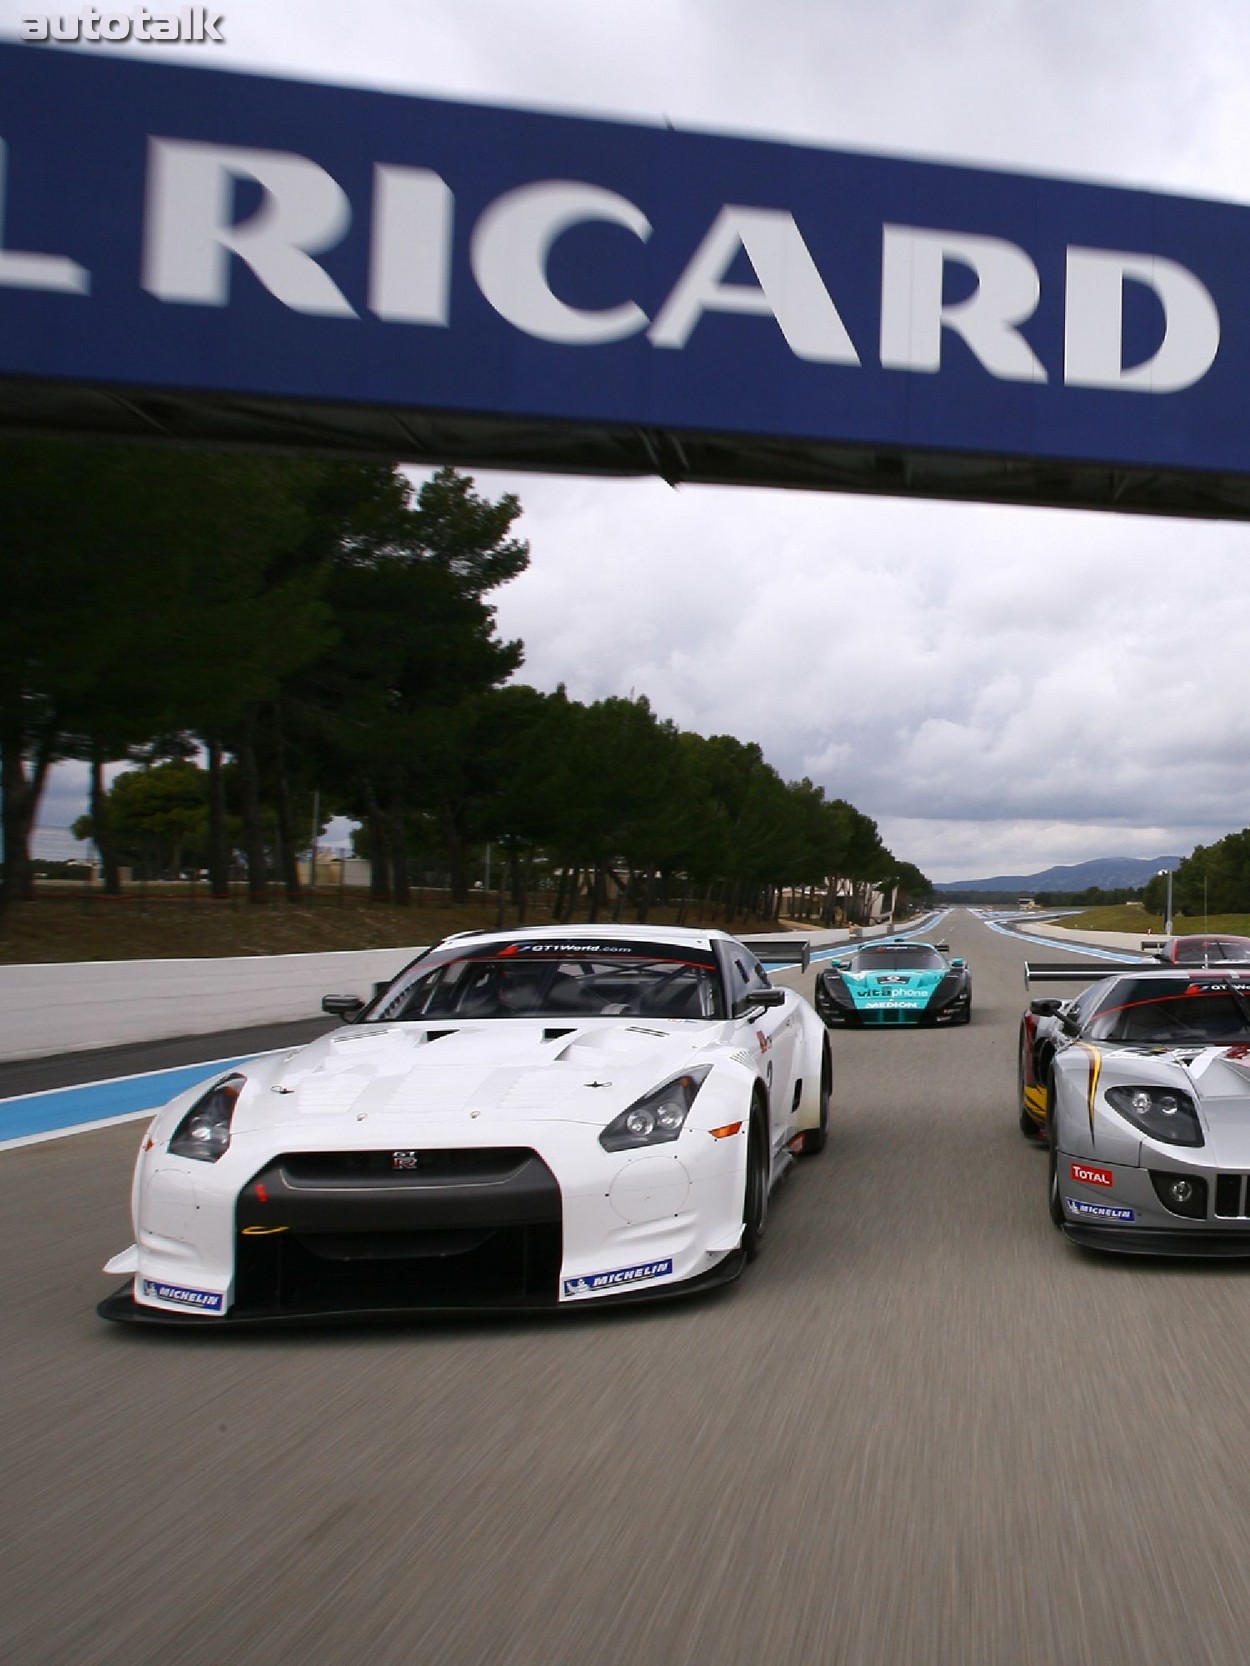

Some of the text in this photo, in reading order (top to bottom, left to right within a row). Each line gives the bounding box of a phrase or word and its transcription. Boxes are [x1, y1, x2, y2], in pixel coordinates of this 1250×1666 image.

[141, 135, 1220, 394] RICARD
[857, 986, 929, 998] vitaphone
[1072, 1166, 1111, 1185] TOTAL
[1079, 1205, 1131, 1218] MICHELIN
[592, 1262, 670, 1286] MICHELIN
[159, 1286, 220, 1305] MICHELIN
